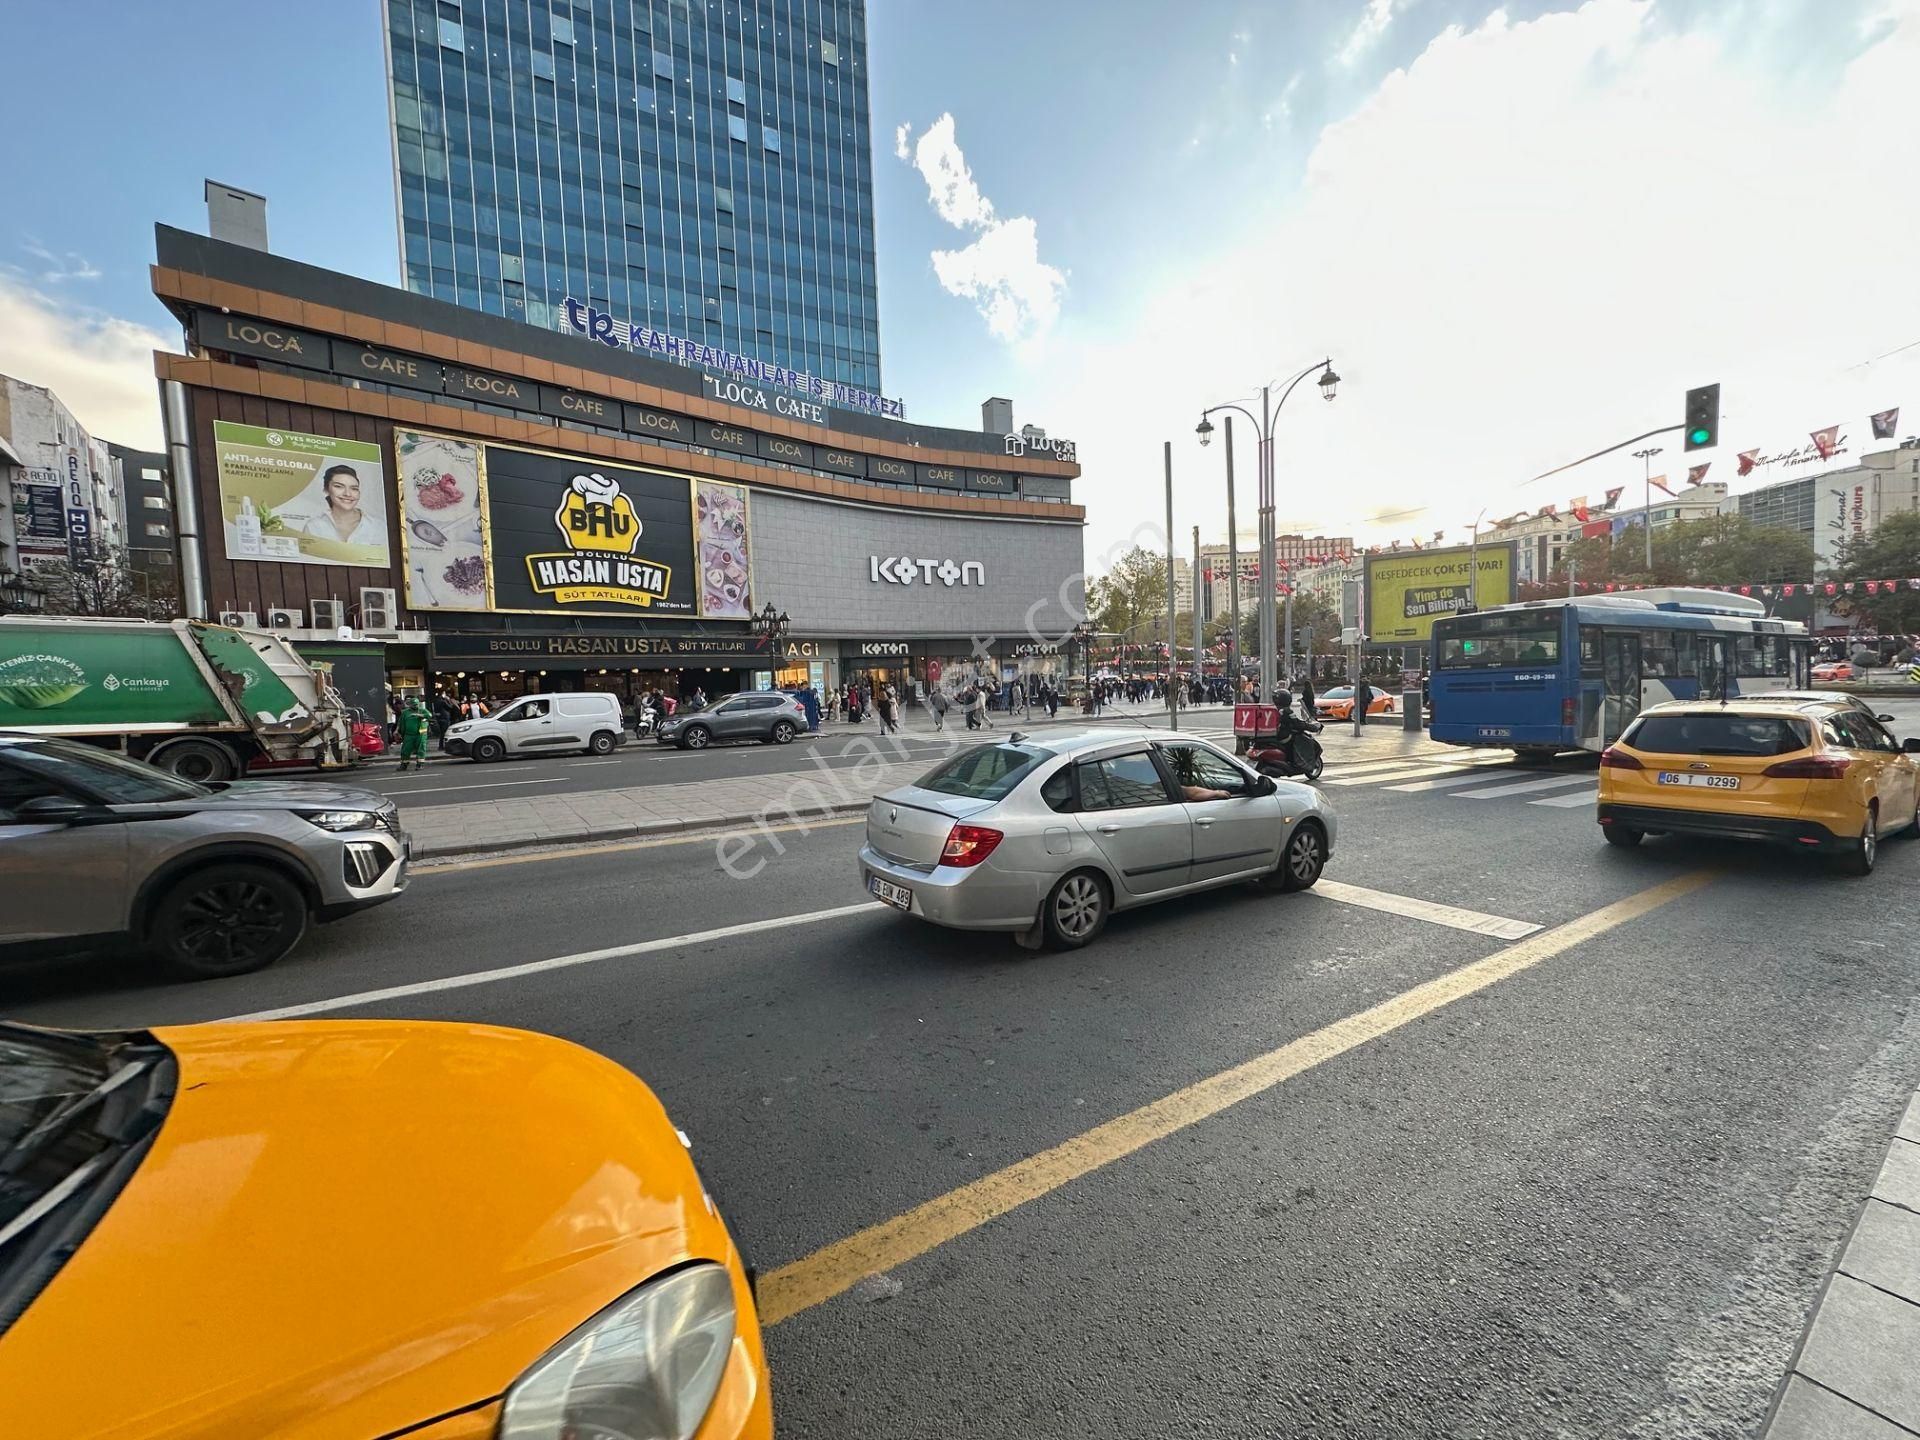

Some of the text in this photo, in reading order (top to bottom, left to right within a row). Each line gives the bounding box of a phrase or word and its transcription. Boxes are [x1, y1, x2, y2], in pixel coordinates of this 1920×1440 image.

[226, 322, 302, 354] LOCA
[360, 352, 418, 378] CAFE
[628, 324, 798, 389] KAHRAMANLAR
[834, 383, 904, 419] MERKEZİ
[465, 374, 520, 398] LOCA
[561, 395, 603, 416] CAFE
[714, 379, 768, 410] LOCA
[775, 396, 824, 424] CAFE
[639, 412, 680, 433] LOCA
[710, 428, 743, 446] CAFE
[1032, 436, 1074, 453] LOCA
[769, 440, 802, 458] LOCA
[1056, 451, 1076, 463] Cafe
[223, 452, 317, 471] ANTI-AGE GLOBAL
[827, 453, 855, 468] CAFE
[878, 462, 907, 476] LOCA
[928, 469, 955, 481] CAFE
[976, 473, 1004, 486] LOCA
[575, 551, 628, 561] BOLULU
[537, 559, 663, 592] HASAN USTA
[1375, 567, 1431, 580] KEŞFEDECEK
[1433, 565, 1455, 577] ÇOK
[1477, 560, 1503, 571] VAR!
[563, 590, 586, 600] SÜT
[1415, 587, 1453, 603] Yine de
[1406, 604, 1425, 616] Sen
[490, 640, 541, 651] BOLULU
[548, 638, 618, 654] HASAN
[624, 638, 672, 653] USTA
[678, 640, 698, 651] SÜT
[36, 654, 84, 677] ÇANKAYA
[1666, 774, 1737, 787] 06 T 0299
